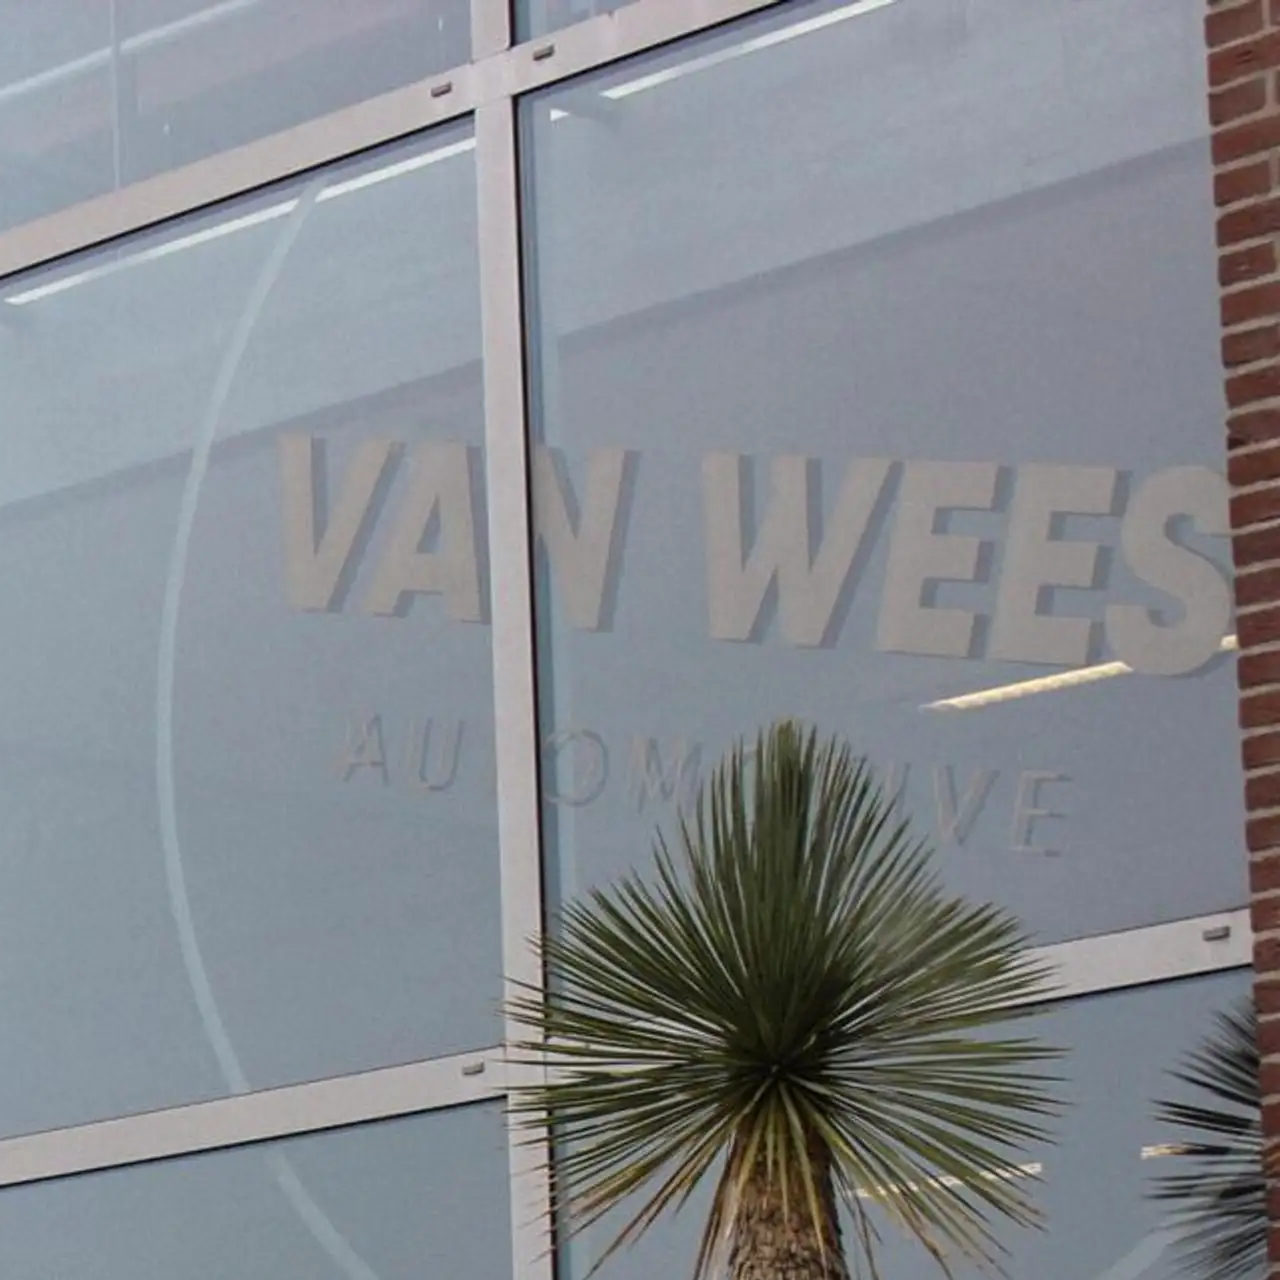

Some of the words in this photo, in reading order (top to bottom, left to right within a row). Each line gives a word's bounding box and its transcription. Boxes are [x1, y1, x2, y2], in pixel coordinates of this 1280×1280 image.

[278, 433, 638, 632] VAN
[702, 450, 1236, 677] WEES
[340, 712, 1072, 858] AUOMIVE
